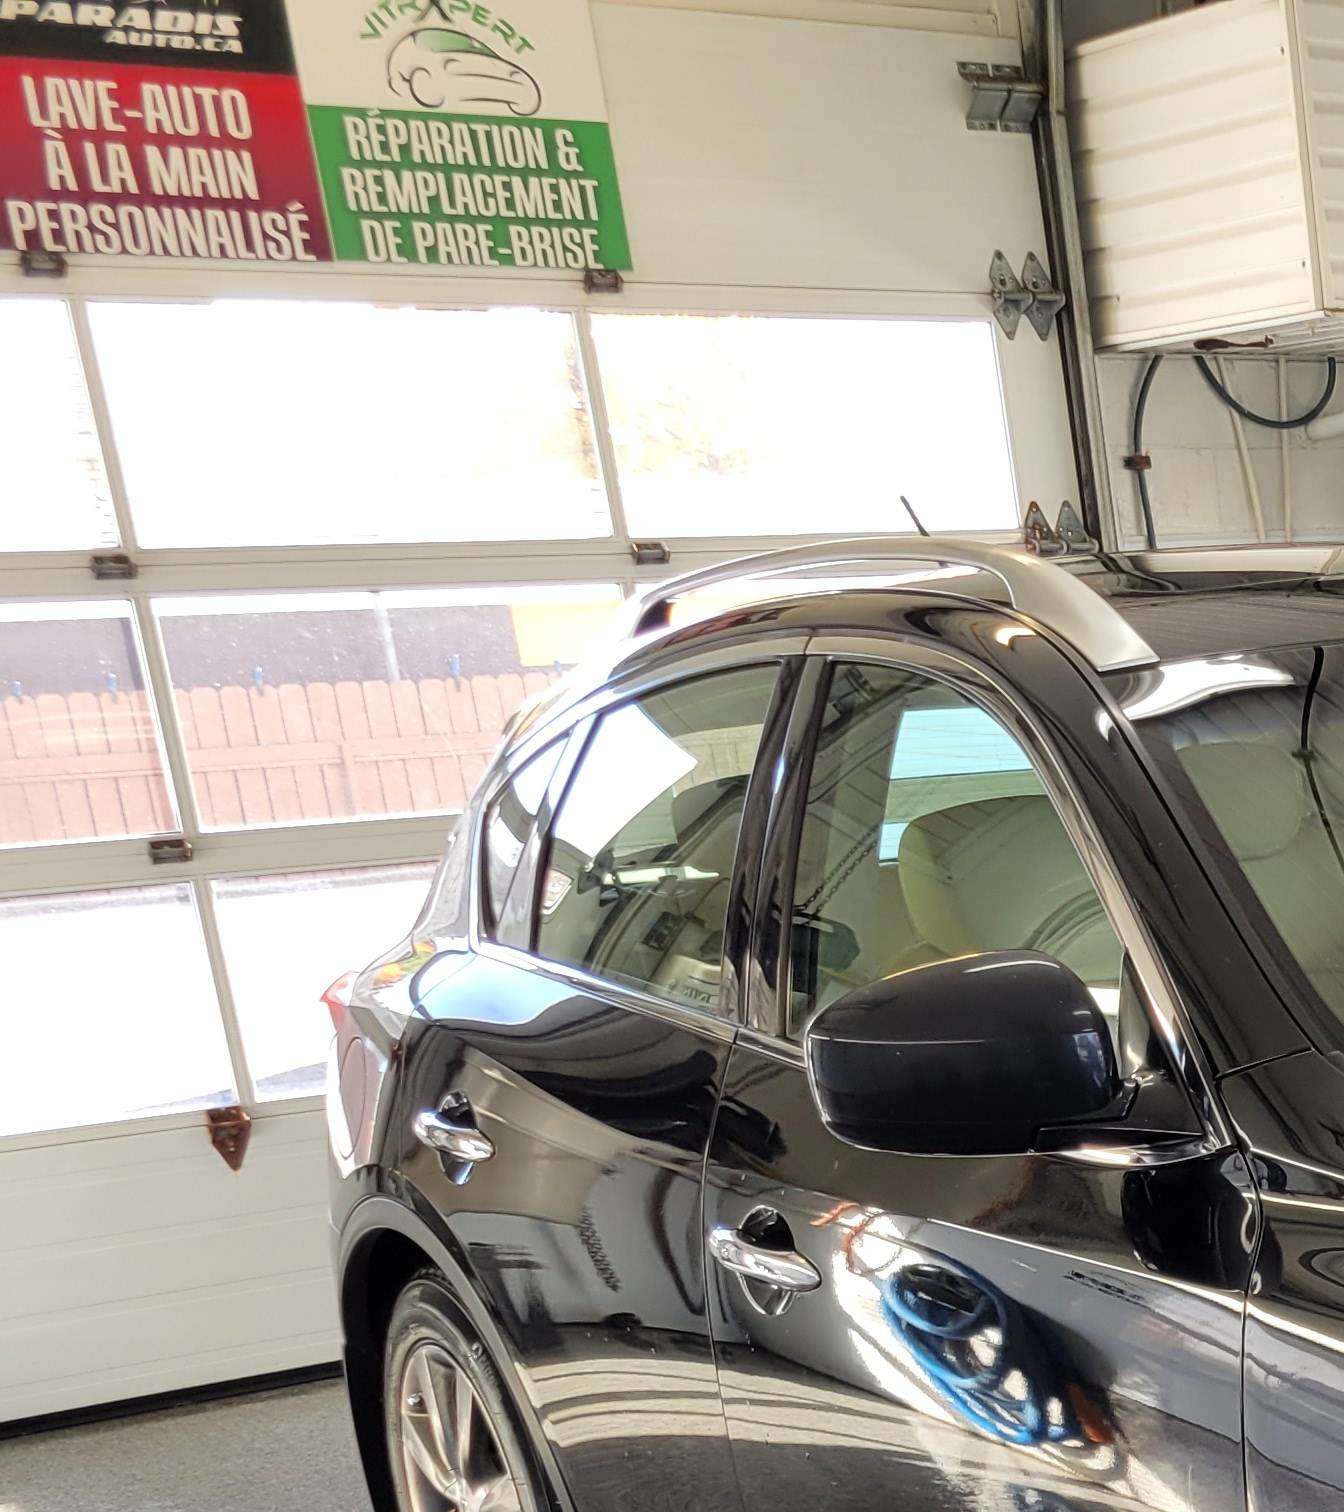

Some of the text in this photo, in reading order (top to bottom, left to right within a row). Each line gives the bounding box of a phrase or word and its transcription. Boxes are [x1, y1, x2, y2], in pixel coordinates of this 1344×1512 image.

[0, 0, 243, 36] PARADIS
[104, 29, 244, 54] AUTO.CA
[22, 77, 253, 140] LAVE-AUTO
[44, 130, 260, 200] À LA MAIN
[344, 107, 582, 172] RÉPARATION &
[342, 169, 599, 221] REMPLACEMENT
[9, 201, 317, 261] PERSONNALISÉ
[362, 219, 604, 268] DE PARE-BRISE
